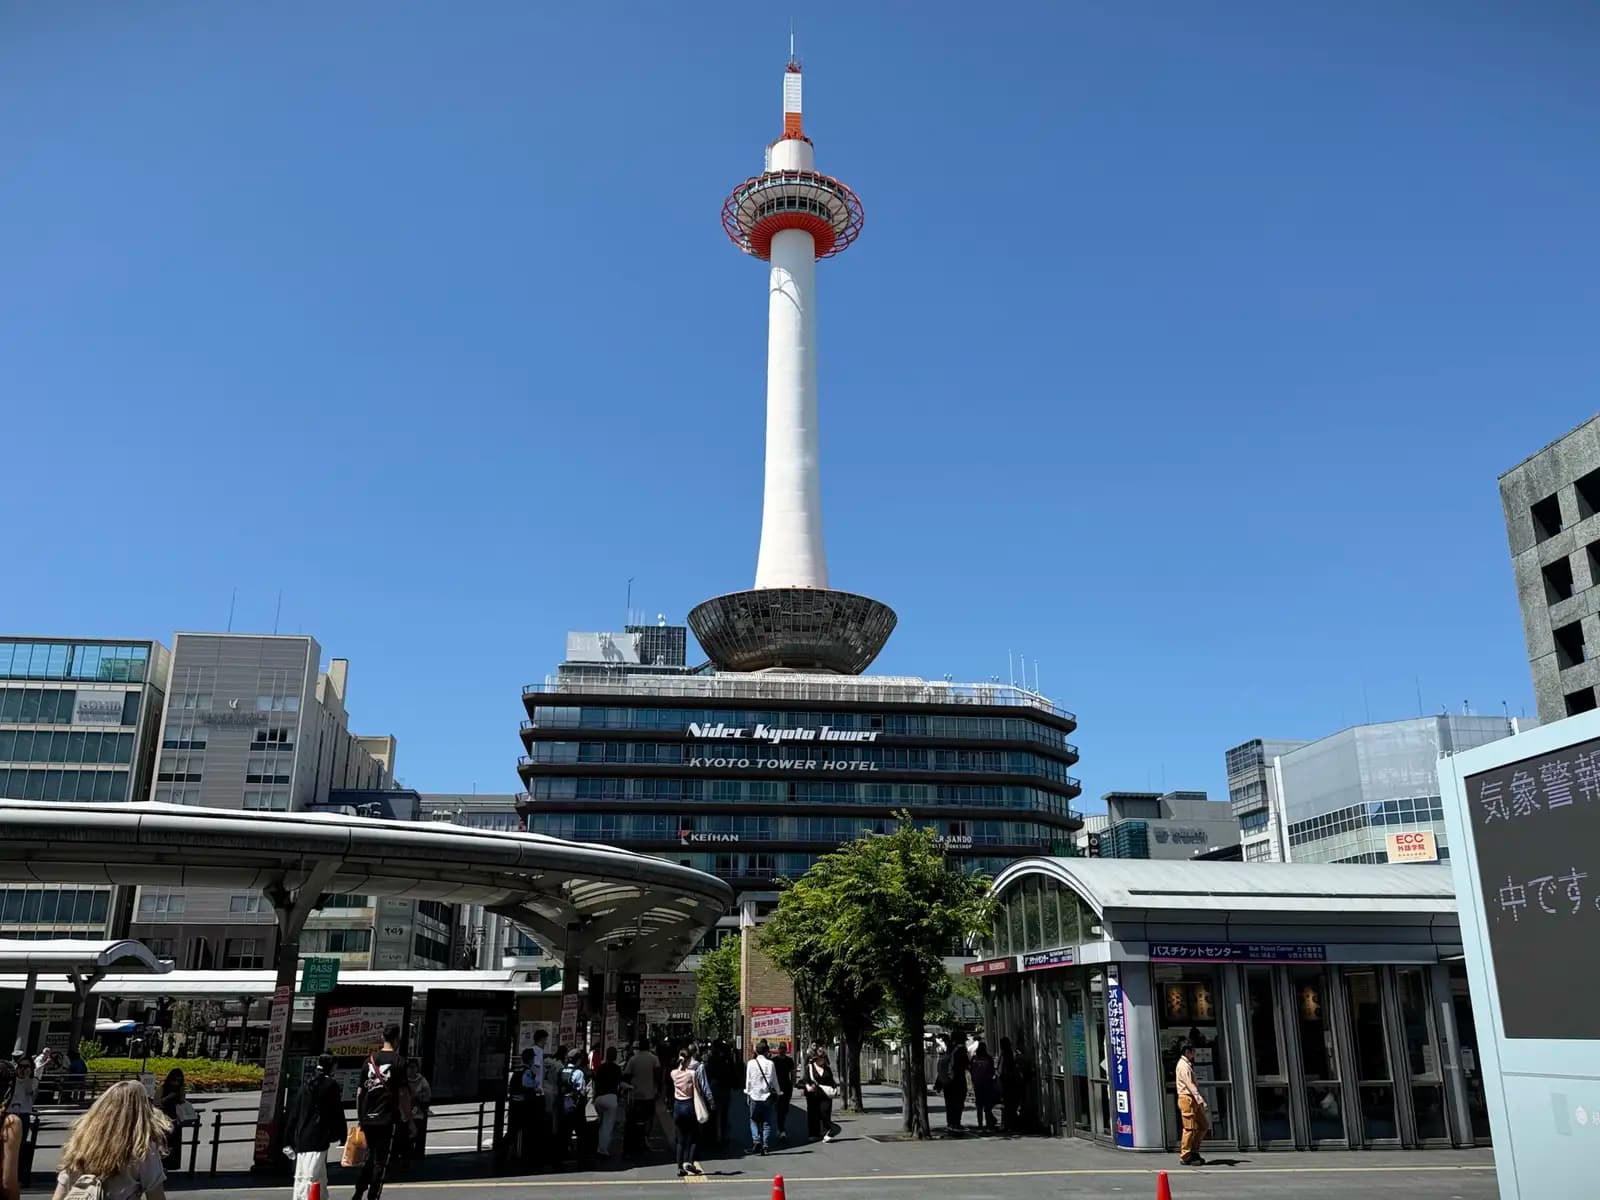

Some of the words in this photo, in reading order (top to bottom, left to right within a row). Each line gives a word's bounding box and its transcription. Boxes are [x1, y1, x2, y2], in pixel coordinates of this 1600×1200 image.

[687, 722, 752, 738] Nidec
[752, 724, 816, 744] Kyoto
[820, 726, 882, 742] Tower
[690, 757, 749, 768] KYOTO
[757, 759, 816, 770] TOWER
[822, 761, 878, 771] HOTEL
[1396, 834, 1424, 844] ECC
[1152, 946, 1241, 957] バスチケットセンター
[328, 1021, 384, 1038] 観光特急バス
